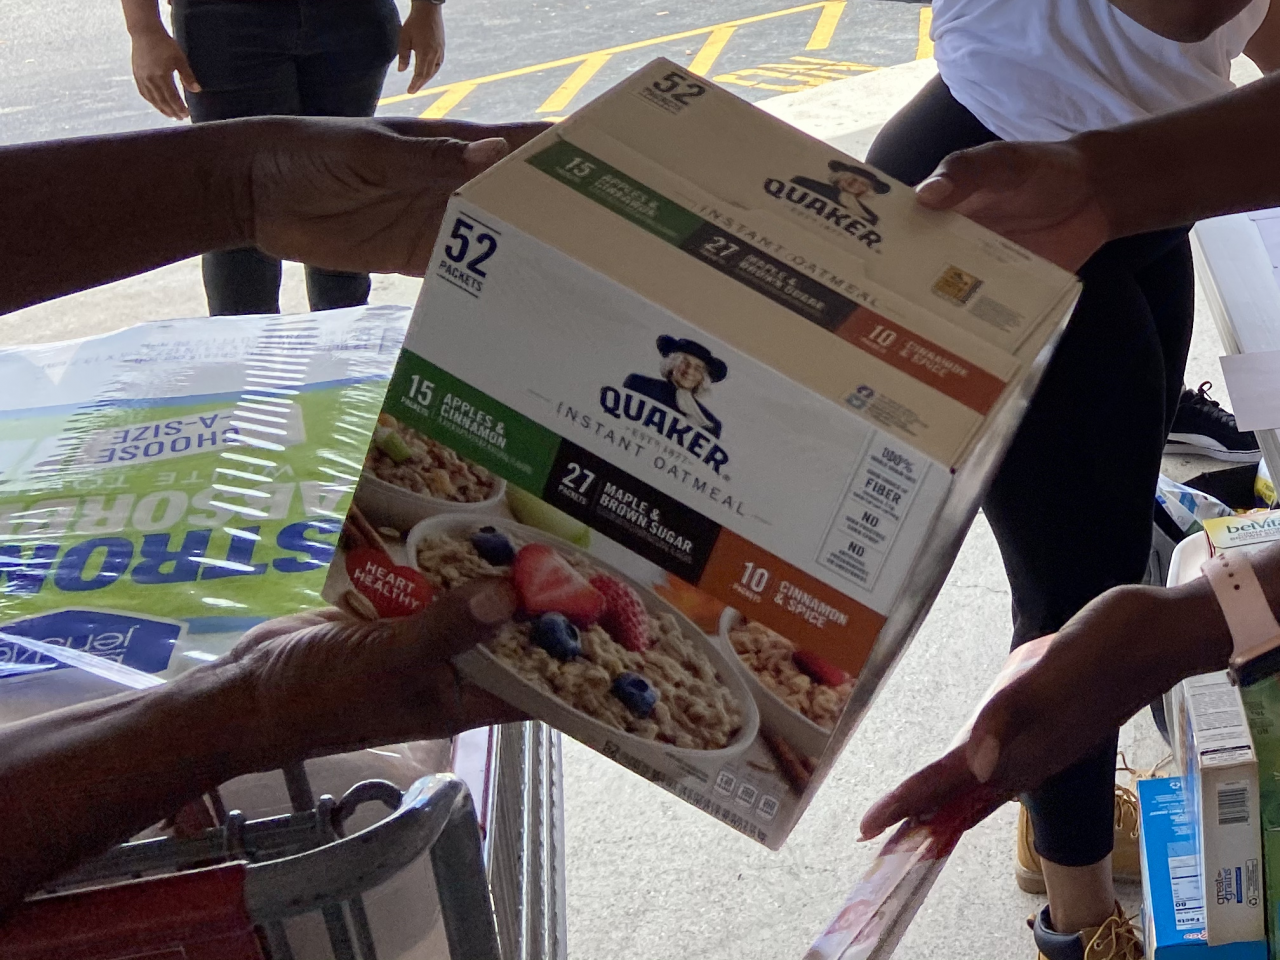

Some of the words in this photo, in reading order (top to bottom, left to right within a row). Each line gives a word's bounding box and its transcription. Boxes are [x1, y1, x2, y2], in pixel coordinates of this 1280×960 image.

[653, 71, 706, 106] 52
[564, 157, 597, 177] 15
[699, 204, 788, 256] INSTANT
[763, 177, 882, 249] QUAKER
[444, 217, 498, 279] 52
[704, 236, 740, 257] 27
[438, 260, 484, 292] PACKETS
[869, 324, 897, 347] 10
[408, 374, 436, 406] 15
[443, 393, 493, 428] APPLES
[440, 404, 507, 450] CINNAMON
[600, 385, 729, 476] QUAKER
[94, 427, 240, 464] CHOOSE
[556, 401, 645, 458] INSTANT
[654, 455, 748, 517] OATMEAL
[561, 462, 596, 494] 27
[603, 482, 650, 514] MAPLE
[864, 477, 902, 505] FIBER
[600, 494, 648, 529] BROWN
[649, 521, 693, 553] SUGAR
[861, 510, 880, 527] NO
[847, 541, 865, 557] NO
[354, 570, 420, 610] HEALTHY
[364, 561, 416, 593] HEART
[741, 562, 769, 592] 10
[779, 581, 849, 627] CINNAMON
[787, 599, 828, 628] SPICE
[1216, 880, 1225, 905] great
[1224, 868, 1237, 903] grains
